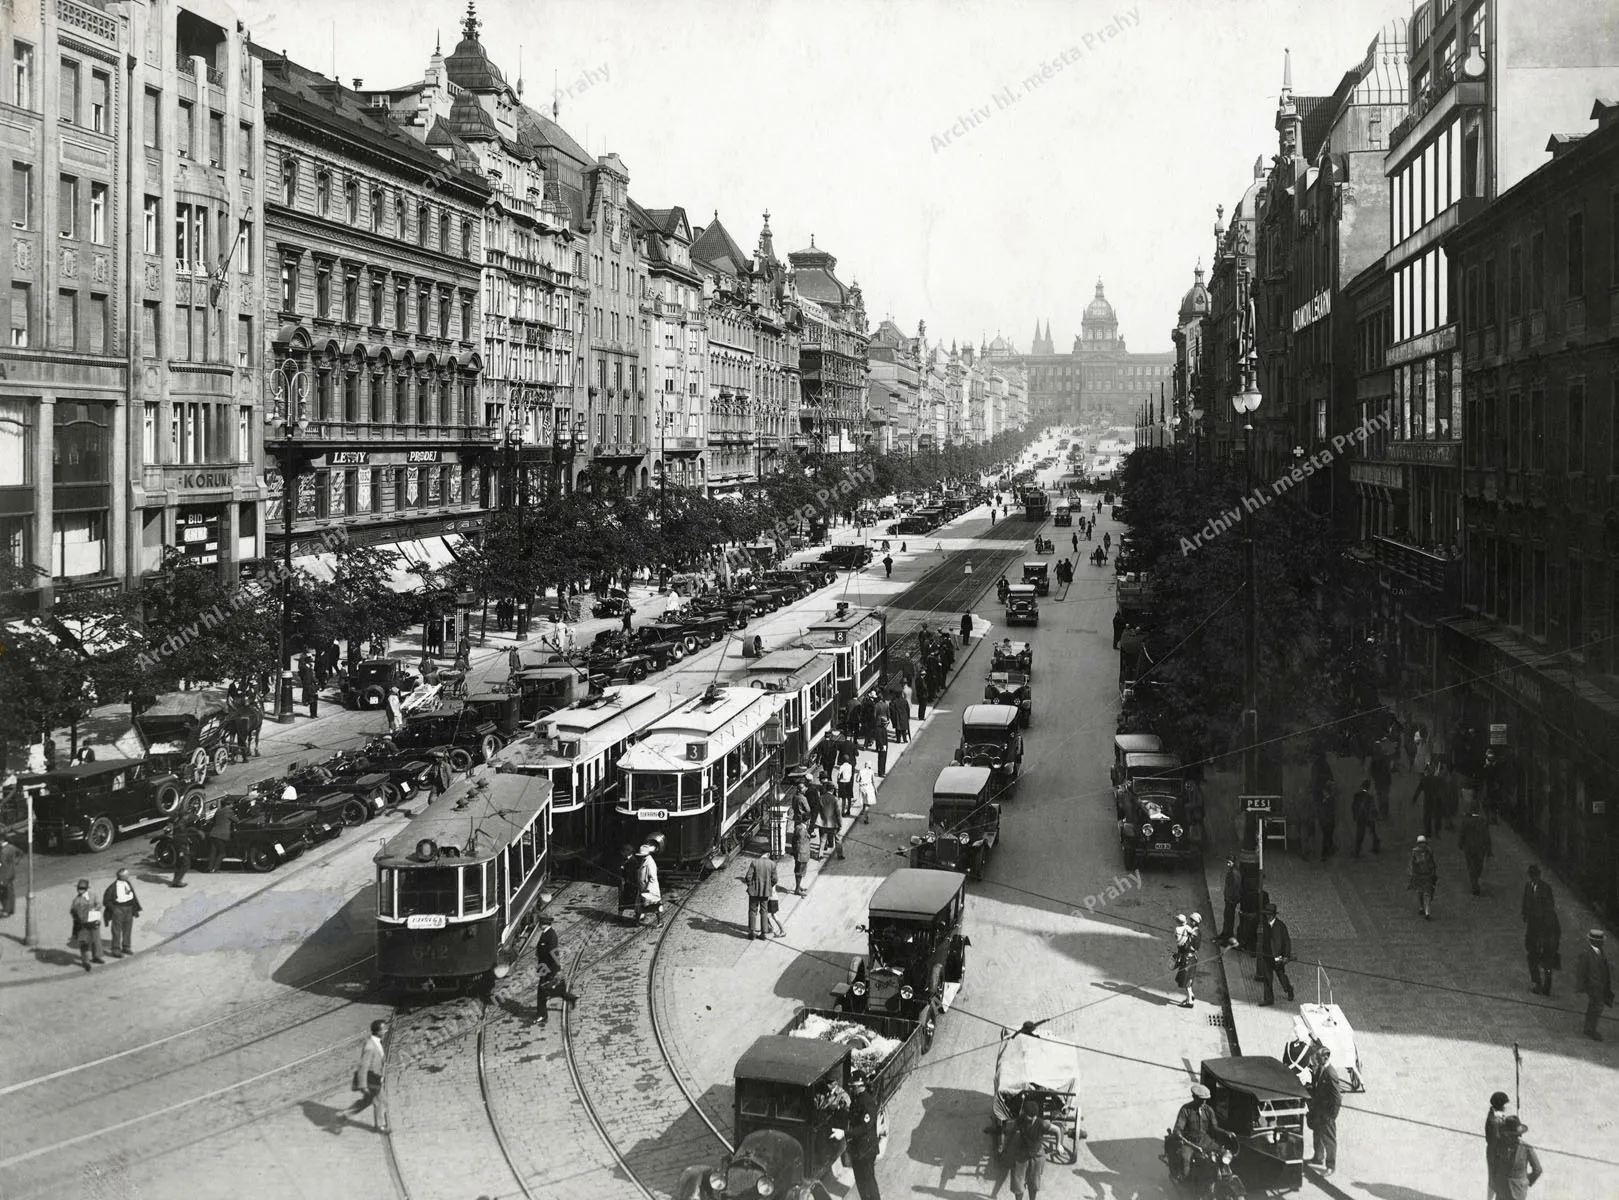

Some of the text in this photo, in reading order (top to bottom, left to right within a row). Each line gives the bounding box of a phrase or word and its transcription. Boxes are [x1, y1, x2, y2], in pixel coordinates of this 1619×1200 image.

[188, 514, 203, 524] BIO
[837, 632, 844, 642] 8
[561, 742, 569, 757] 7
[690, 745, 698, 760] 3
